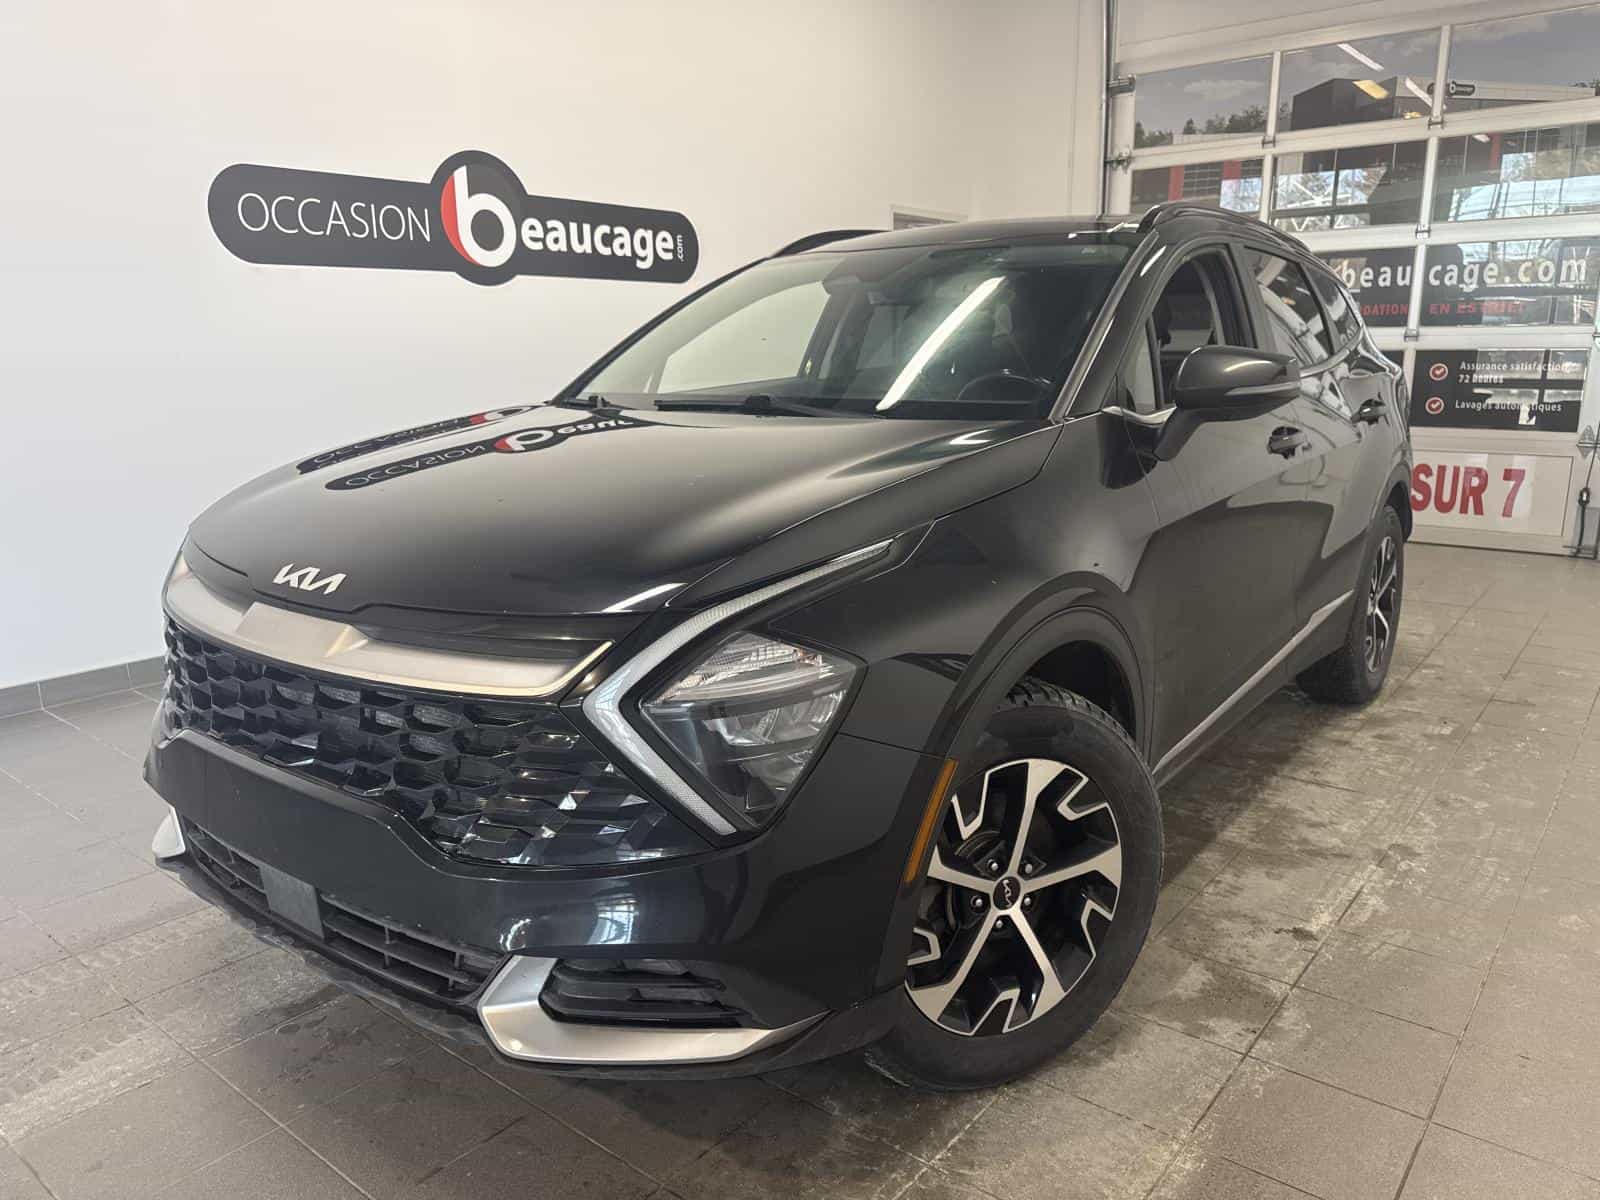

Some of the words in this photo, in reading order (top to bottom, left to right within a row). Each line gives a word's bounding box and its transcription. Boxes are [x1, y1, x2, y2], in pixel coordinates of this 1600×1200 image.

[236, 192, 432, 243] OCCASION
[1459, 361, 1508, 372] Assurance
[1458, 374, 1470, 384] 72
[1455, 399, 1493, 411] Lavages
[1494, 400, 1562, 413] automtiques
[1410, 463, 1489, 516] SUR
[1502, 468, 1526, 518] 7
[272, 563, 347, 595] KIA
